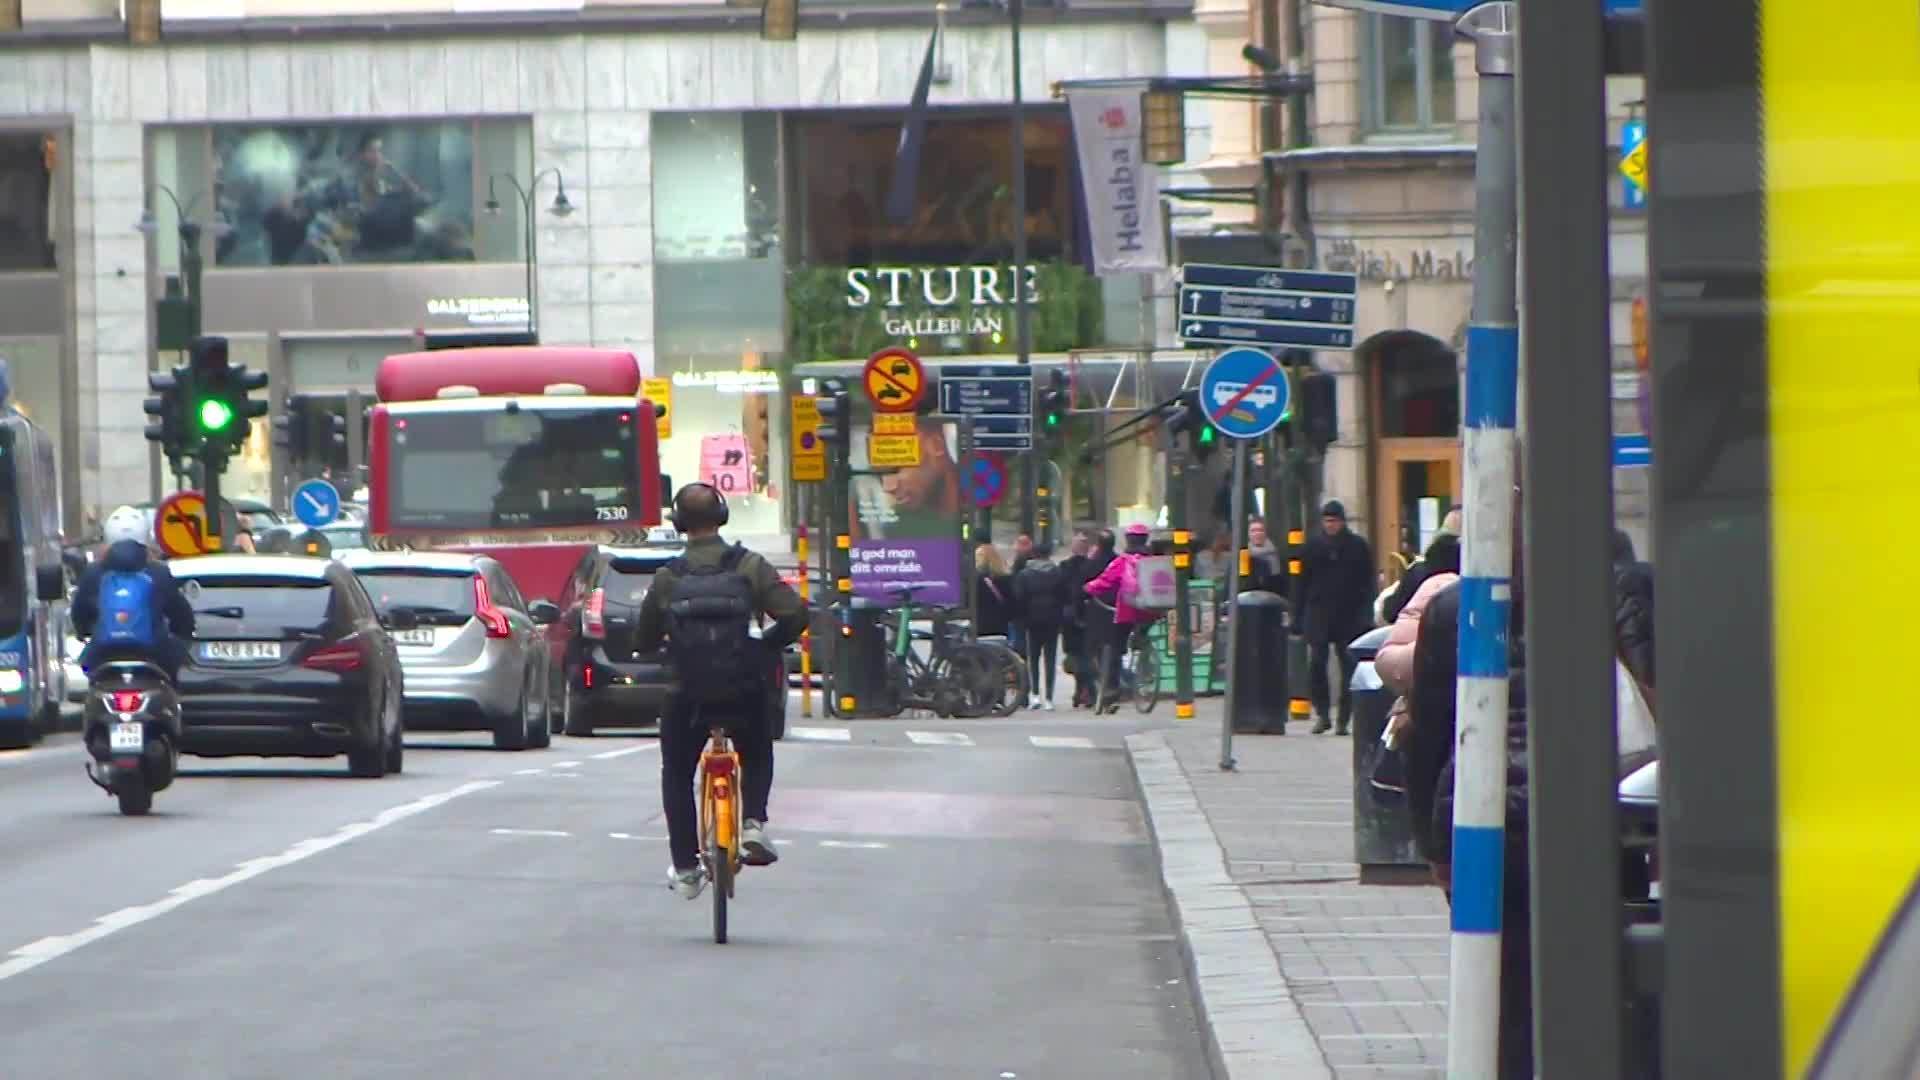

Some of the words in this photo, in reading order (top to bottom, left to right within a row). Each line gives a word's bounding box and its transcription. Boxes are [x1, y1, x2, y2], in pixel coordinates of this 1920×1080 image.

[1109, 148, 1143, 251] Helaba
[847, 265, 1040, 307] STURE
[595, 506, 628, 520] 7530
[861, 547, 886, 561] god
